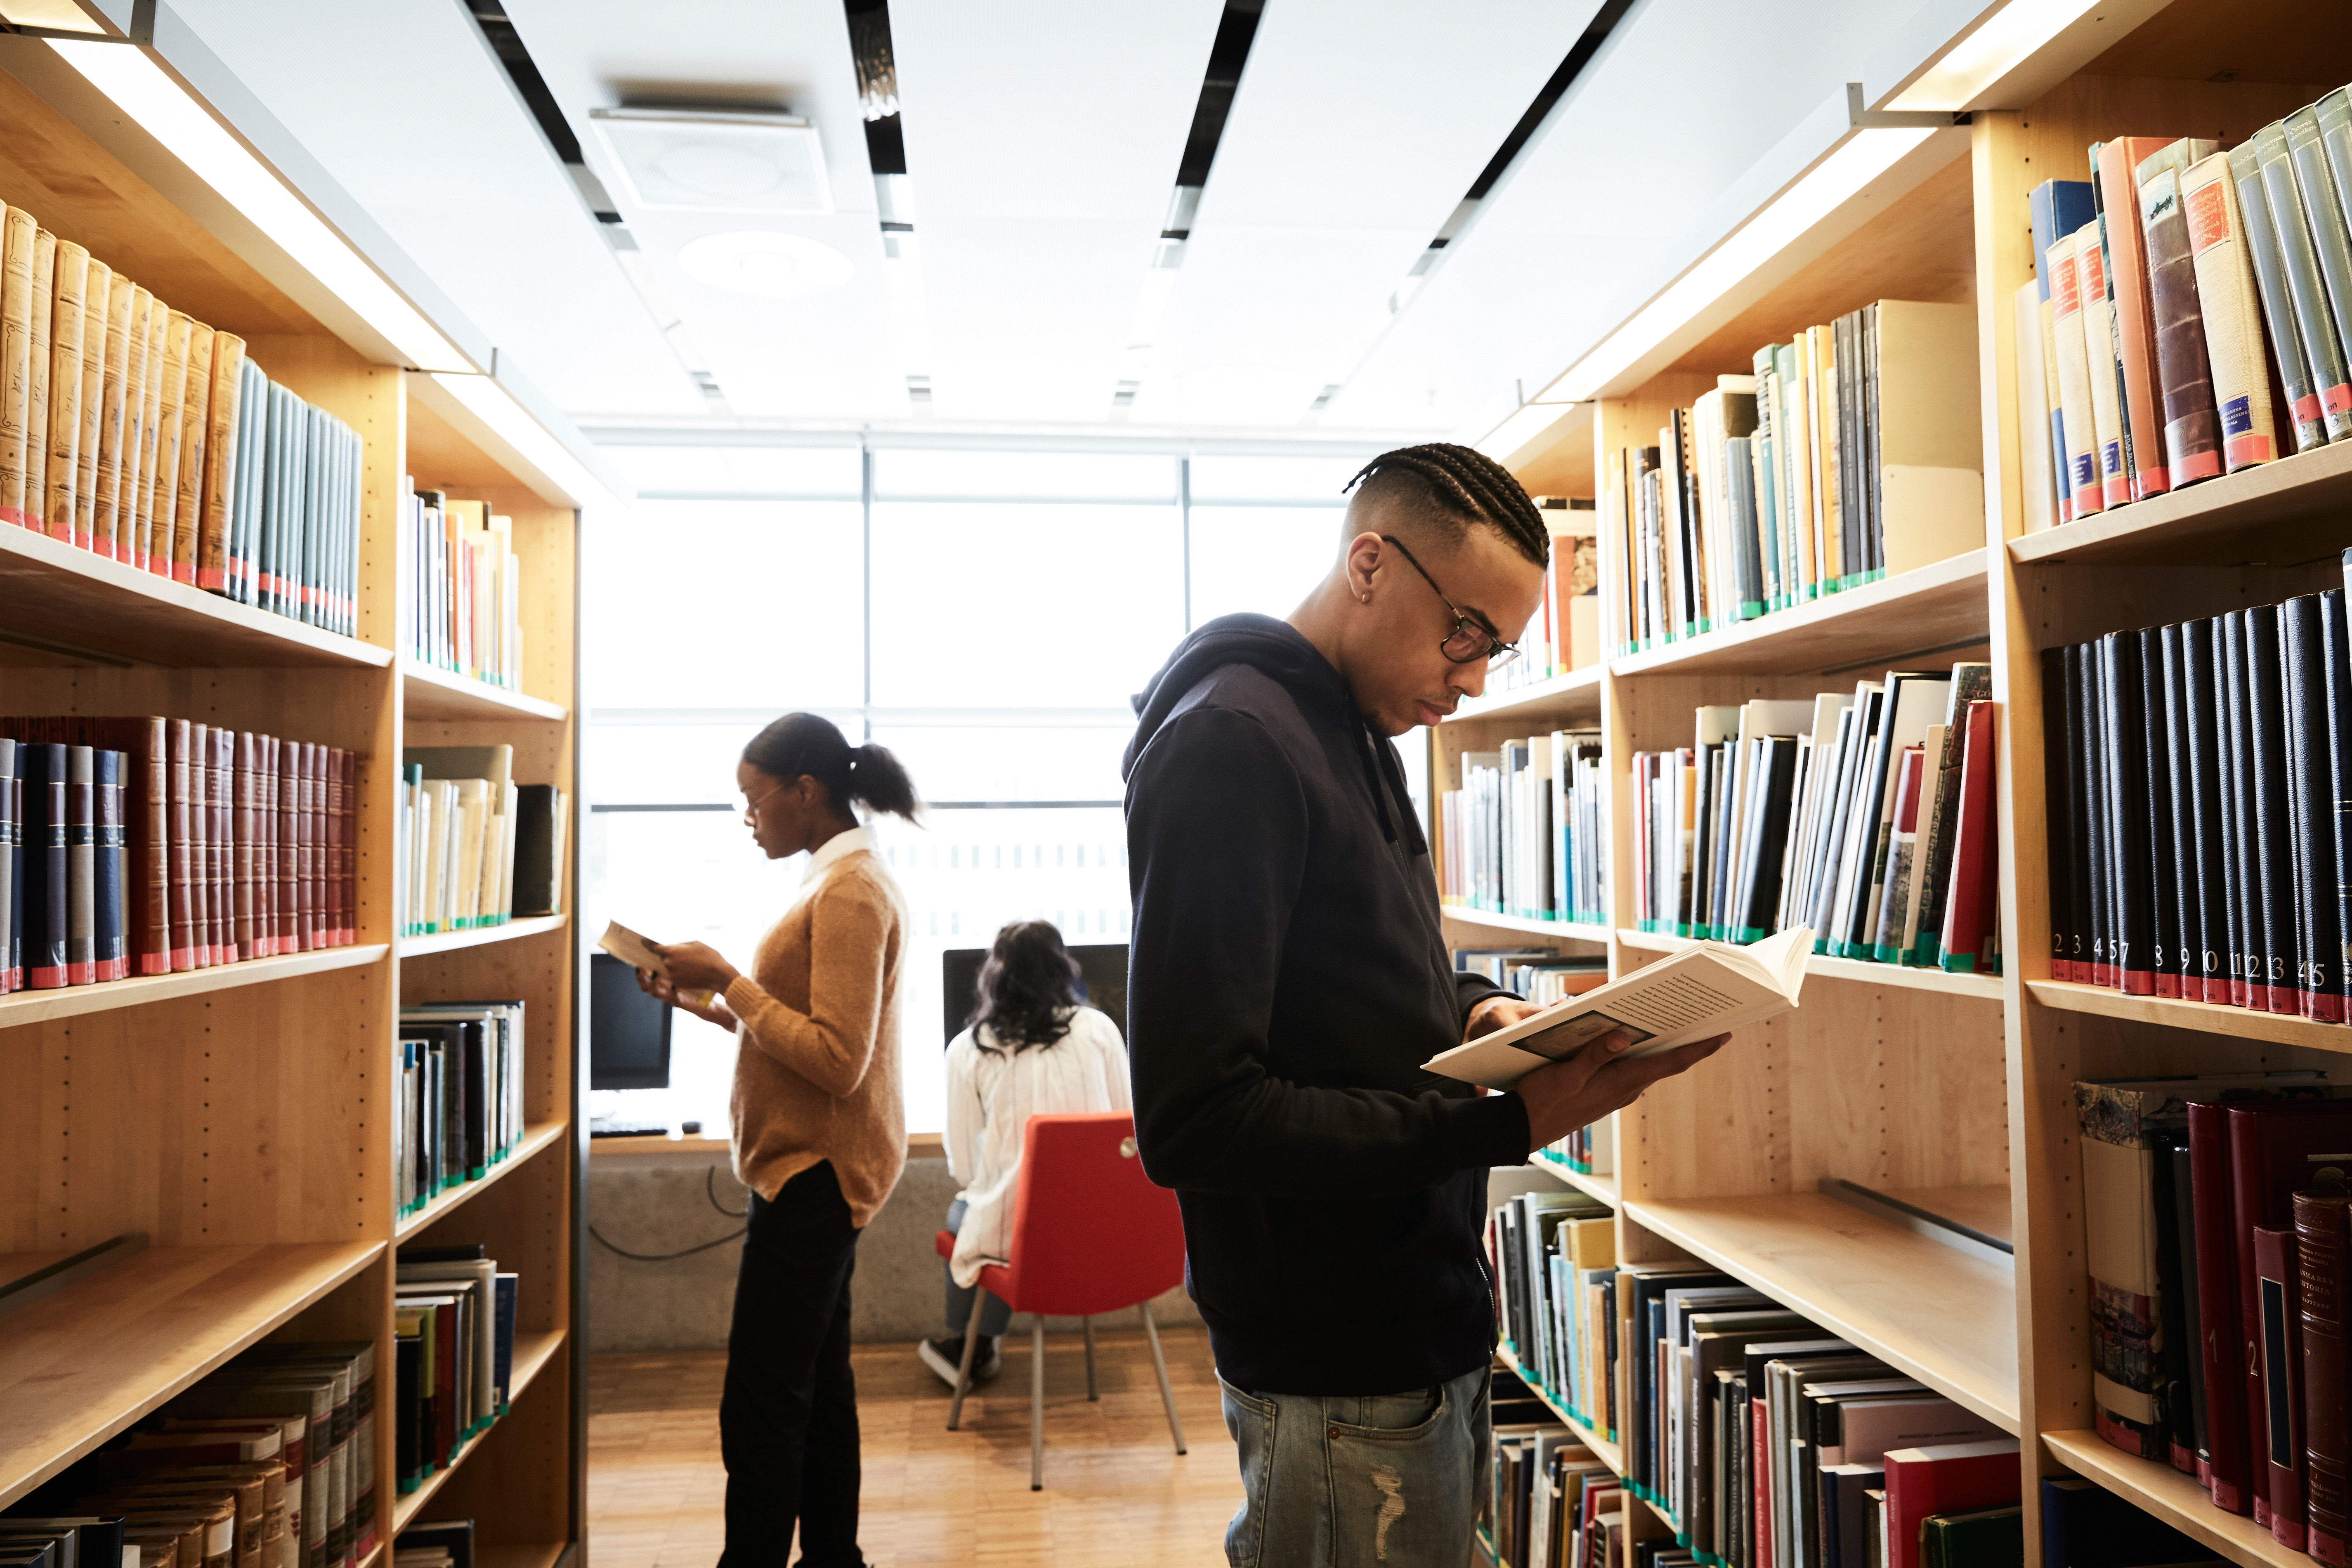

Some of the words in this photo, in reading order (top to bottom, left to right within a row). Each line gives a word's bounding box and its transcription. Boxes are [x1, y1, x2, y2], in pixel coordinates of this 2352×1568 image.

[2054, 933, 2063, 952] 2
[2073, 935, 2081, 954] 3
[2094, 937, 2103, 957] 4
[2109, 939, 2118, 959] 5
[2120, 942, 2129, 963] 7
[2155, 945, 2163, 966] 8
[2180, 948, 2190, 969] 9
[2267, 956, 2285, 980] 13
[2298, 960, 2309, 983] 4
[2312, 1008, 2325, 1017] Bra
[2209, 1329, 2217, 1363] 1
[2248, 1340, 2258, 1377] 2
[2275, 1528, 2286, 1540] Cuv
[2313, 1534, 2317, 1542] K
[2313, 1544, 2326, 1556] Dan
